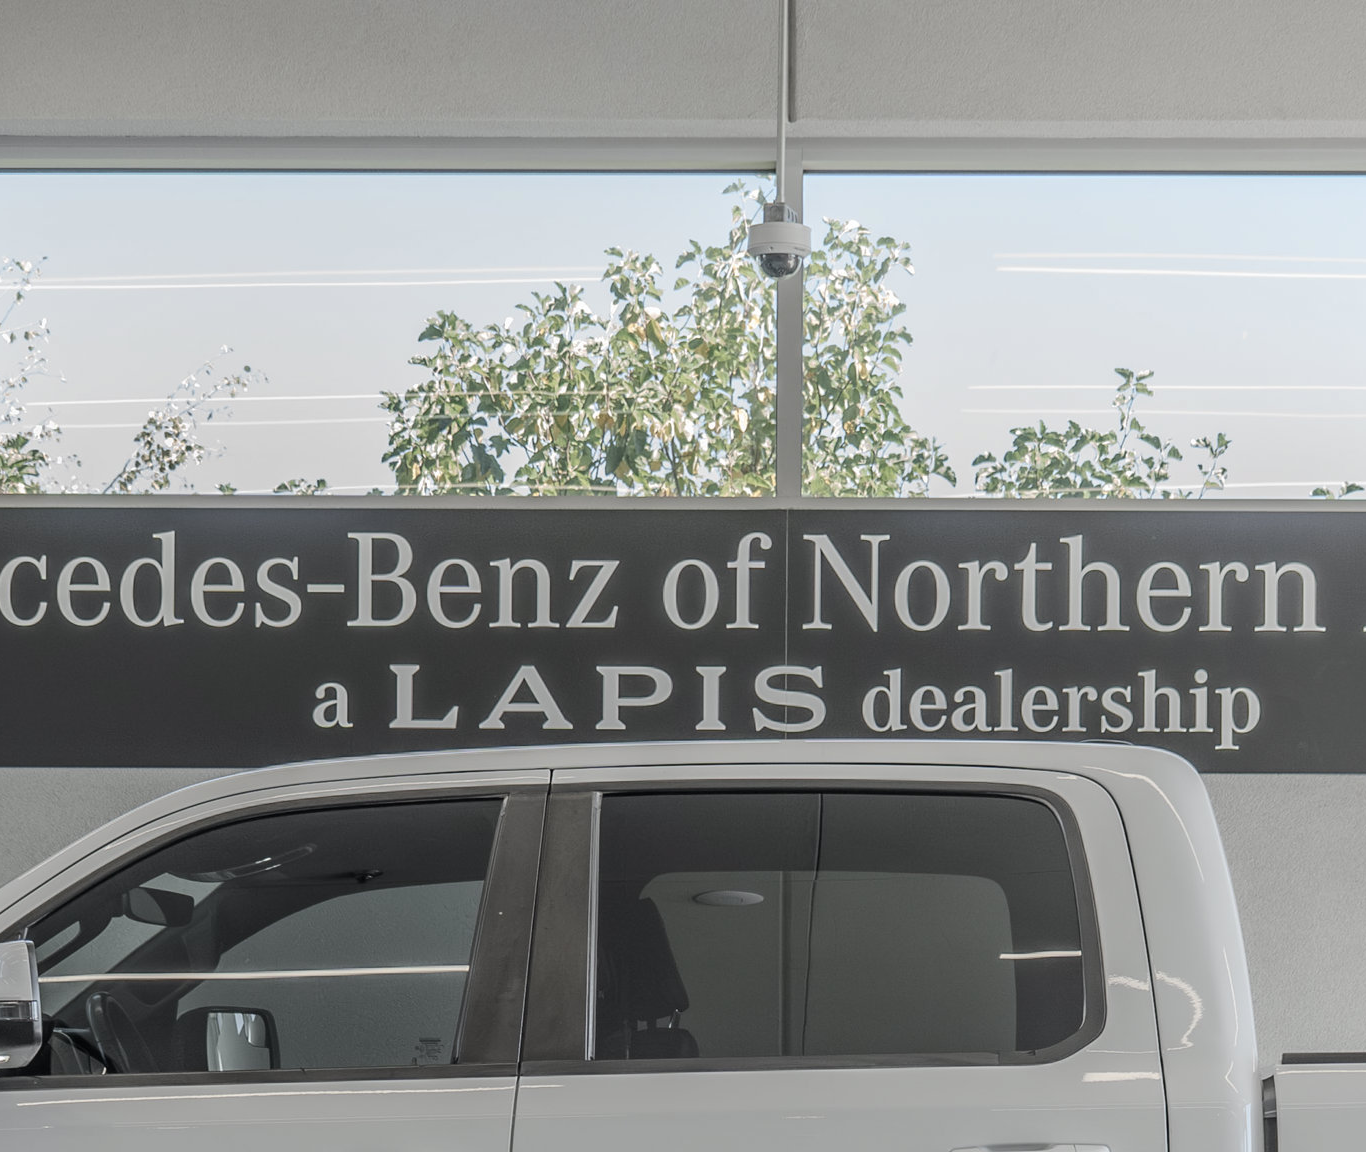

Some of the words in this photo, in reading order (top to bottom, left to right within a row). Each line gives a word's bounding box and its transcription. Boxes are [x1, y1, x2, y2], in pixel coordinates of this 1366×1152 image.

[661, 530, 774, 631] of
[800, 532, 1328, 634] Northern
[311, 681, 355, 729] a
[387, 663, 828, 734] LAPIS
[860, 666, 1262, 752] dealership
